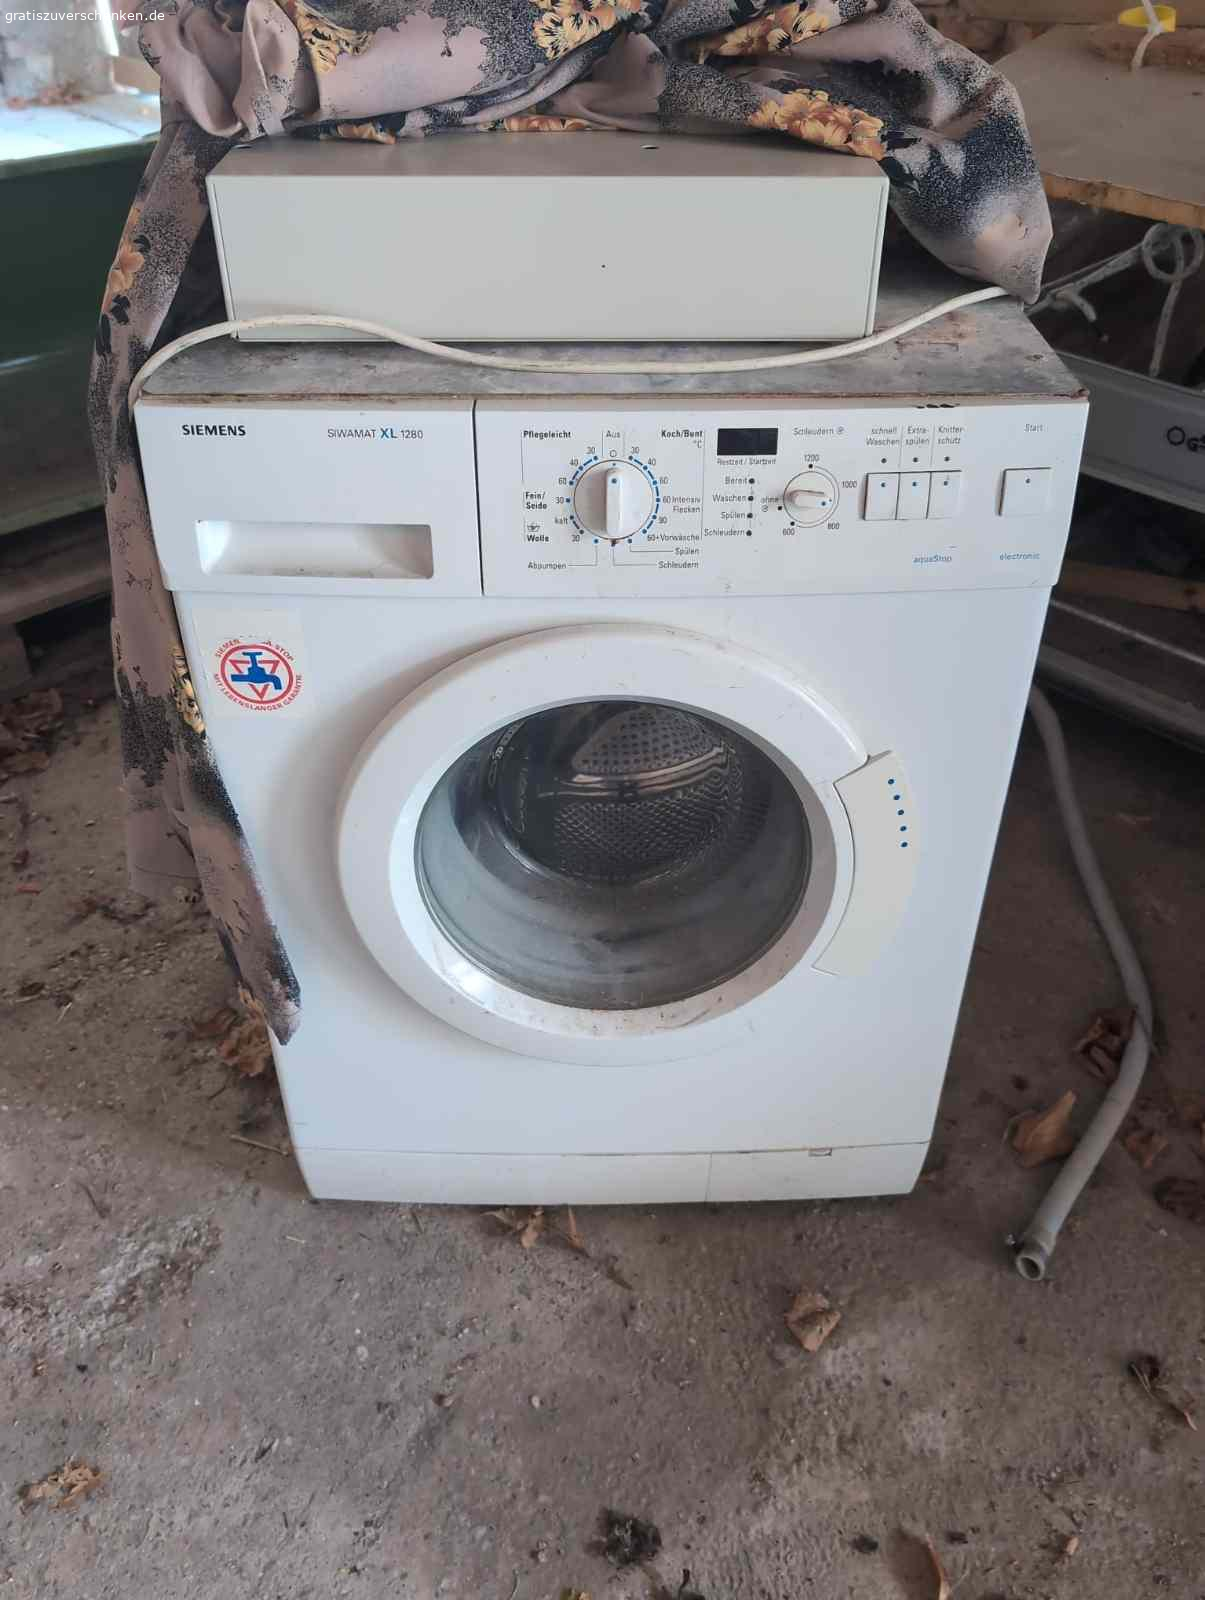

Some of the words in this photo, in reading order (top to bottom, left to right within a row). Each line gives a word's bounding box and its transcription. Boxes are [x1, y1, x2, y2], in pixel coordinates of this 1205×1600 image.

[182, 424, 246, 436] SIEMENS
[793, 427, 834, 436] Schleudern
[871, 426, 898, 435] schnell
[1024, 423, 1044, 432] Start
[327, 428, 376, 438] SIWAMAT
[380, 428, 398, 439] XL
[401, 430, 424, 440] 1280
[523, 430, 572, 440] Pflegeleicht
[606, 430, 620, 438] Aus
[660, 430, 703, 438] Koch/Bunt
[866, 437, 900, 446] Waschen
[938, 436, 961, 446] schutz
[586, 446, 596, 455] 30
[630, 446, 640, 455] 30
[570, 458, 579, 467] 40
[648, 458, 657, 467] 40
[804, 454, 820, 463] 1200
[558, 477, 567, 486] 60
[724, 476, 748, 485] Bereit
[842, 480, 858, 489] 1000
[525, 491, 546, 500] Fein/
[556, 496, 564, 504] 30
[662, 496, 671, 504] 60
[712, 494, 746, 503] Waschen
[760, 496, 780, 504] ohne
[526, 502, 548, 510] Seide
[554, 516, 568, 525] kalt
[720, 511, 746, 521] Spülen
[827, 522, 840, 530] 800
[704, 528, 746, 538] Schleudern
[782, 528, 796, 536] 600
[526, 534, 550, 542] Wolle
[572, 534, 580, 543] 30
[674, 546, 700, 557] Spülen
[912, 553, 953, 565] aquaStop
[999, 552, 1041, 561] electronic
[528, 561, 567, 571] Abpumpen
[658, 560, 700, 569] Schleudern
